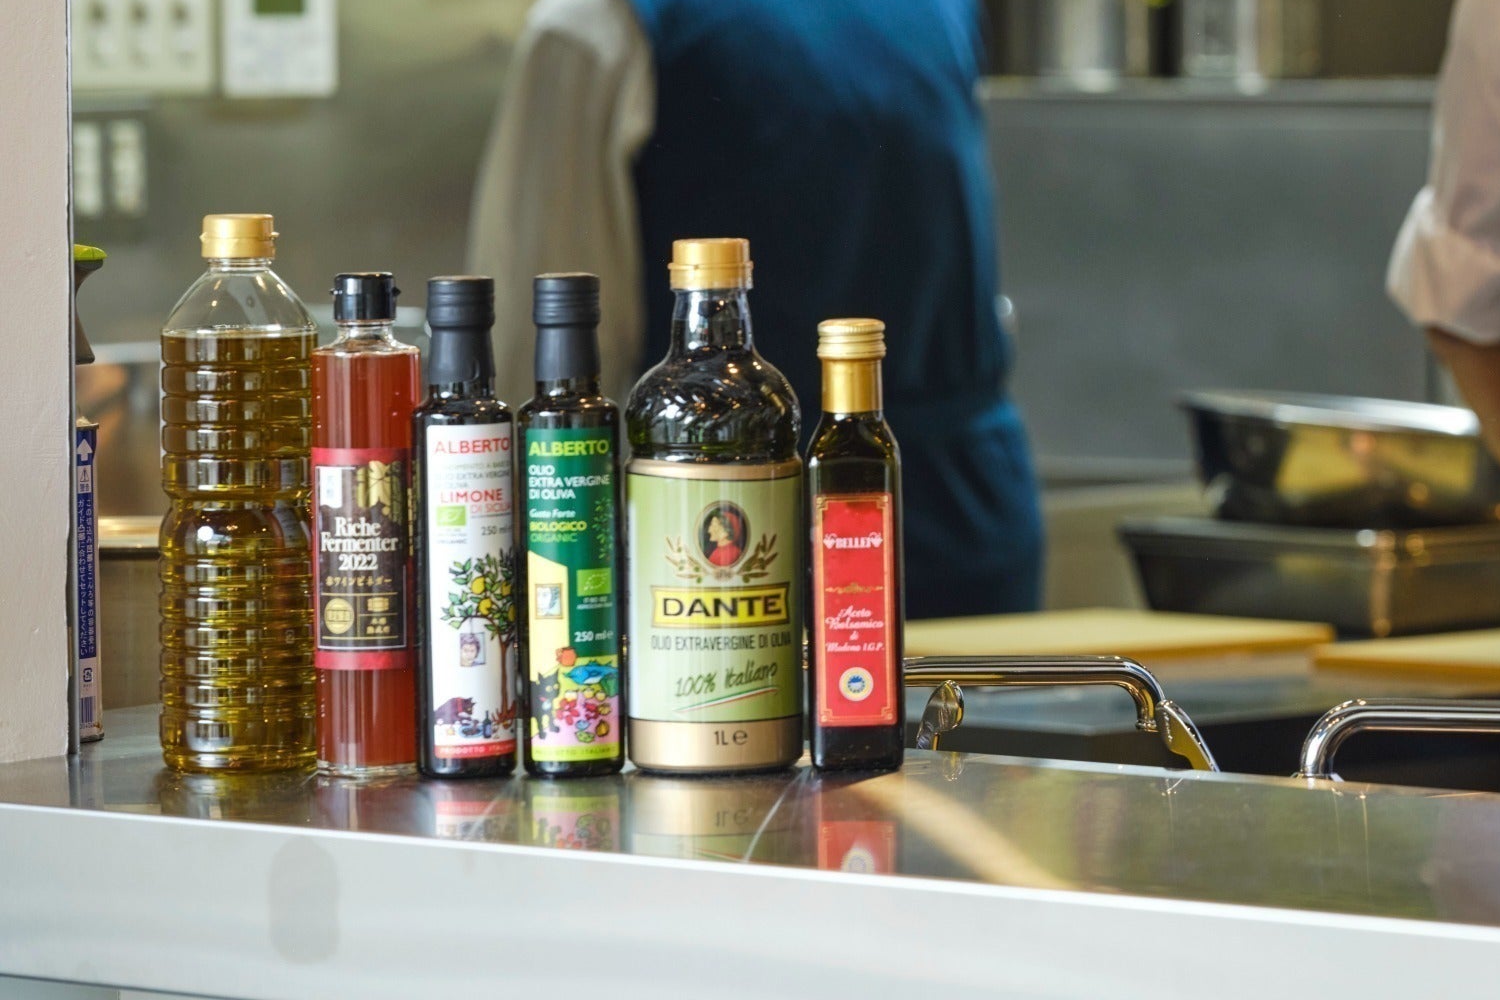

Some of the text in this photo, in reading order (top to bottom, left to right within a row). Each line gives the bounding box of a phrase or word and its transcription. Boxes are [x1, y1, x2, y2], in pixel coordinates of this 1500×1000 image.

[434, 437, 511, 454] ALBERTO
[528, 439, 609, 456] ALBERTO
[528, 464, 556, 476] OLIO
[528, 474, 611, 488] EXTRA VERGINE
[440, 488, 503, 503] LIMONE
[528, 488, 577, 500] DI OLIVA
[552, 508, 576, 518] Forte
[334, 516, 382, 537] Riche
[481, 525, 497, 536] 250
[529, 520, 587, 532] BIOLOGICO
[321, 531, 399, 552] Fermenter
[530, 533, 578, 542] ORGANIC
[338, 553, 379, 571] 2022
[663, 593, 782, 617] DANTE
[837, 604, 873, 618] Aceto
[824, 614, 884, 630] Balsamico
[574, 630, 594, 642] 250
[651, 631, 792, 651] OLIO EXTRAVERGINE DI OLIVA
[675, 670, 718, 697] 100%
[713, 731, 729, 746] 1L
